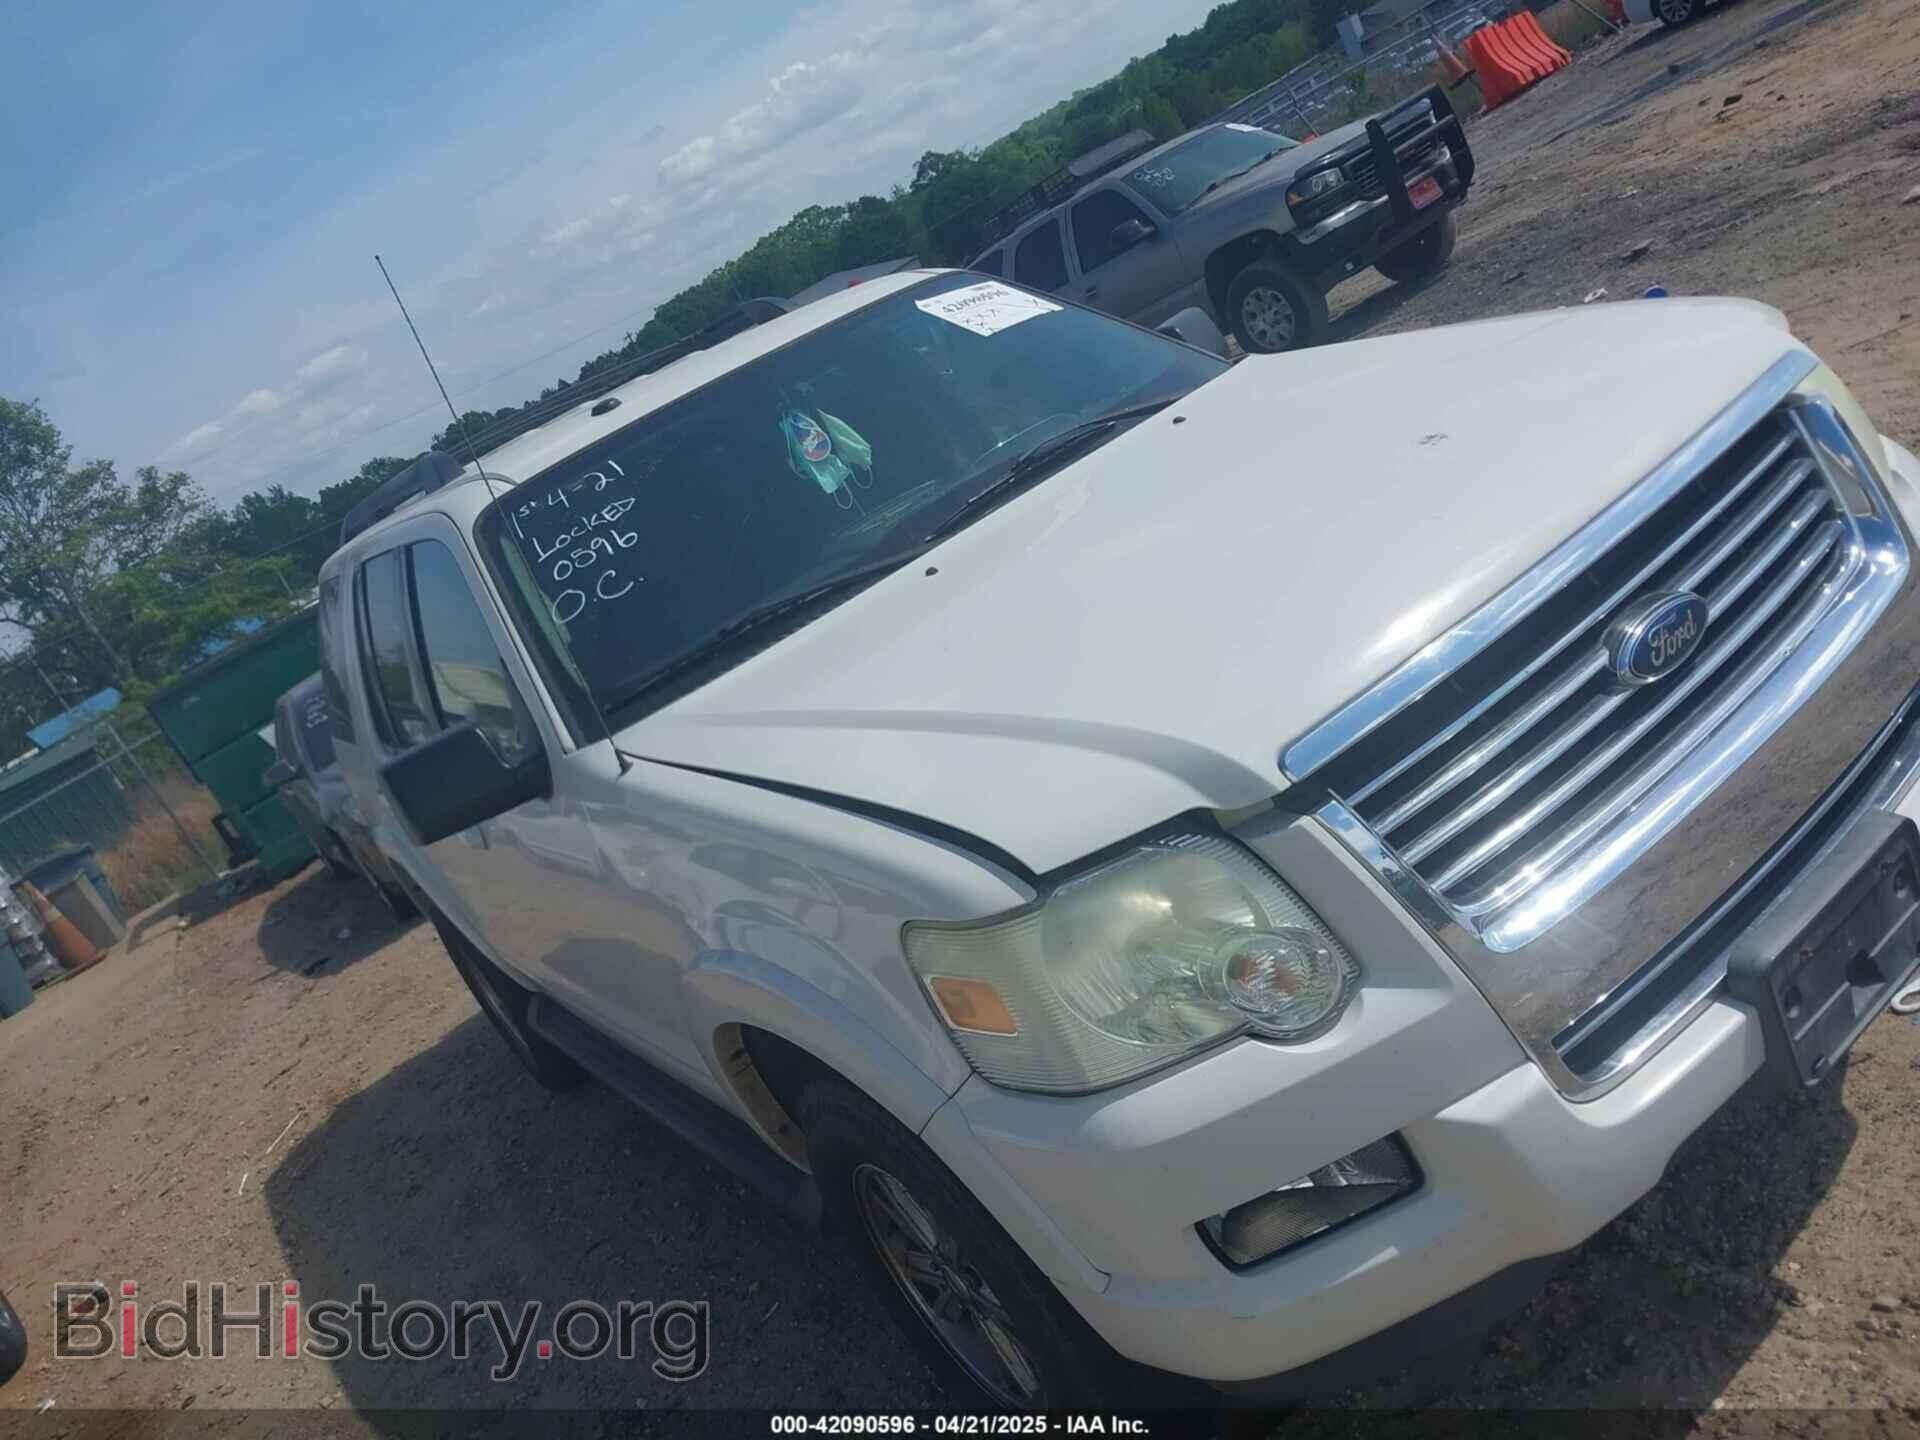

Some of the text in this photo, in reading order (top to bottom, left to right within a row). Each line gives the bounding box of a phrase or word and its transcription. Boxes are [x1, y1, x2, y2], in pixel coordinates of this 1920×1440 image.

[548, 460, 625, 508] 4-21
[532, 497, 636, 563] LOCKED
[553, 529, 638, 581] 0596
[1648, 608, 1697, 667] Ford
